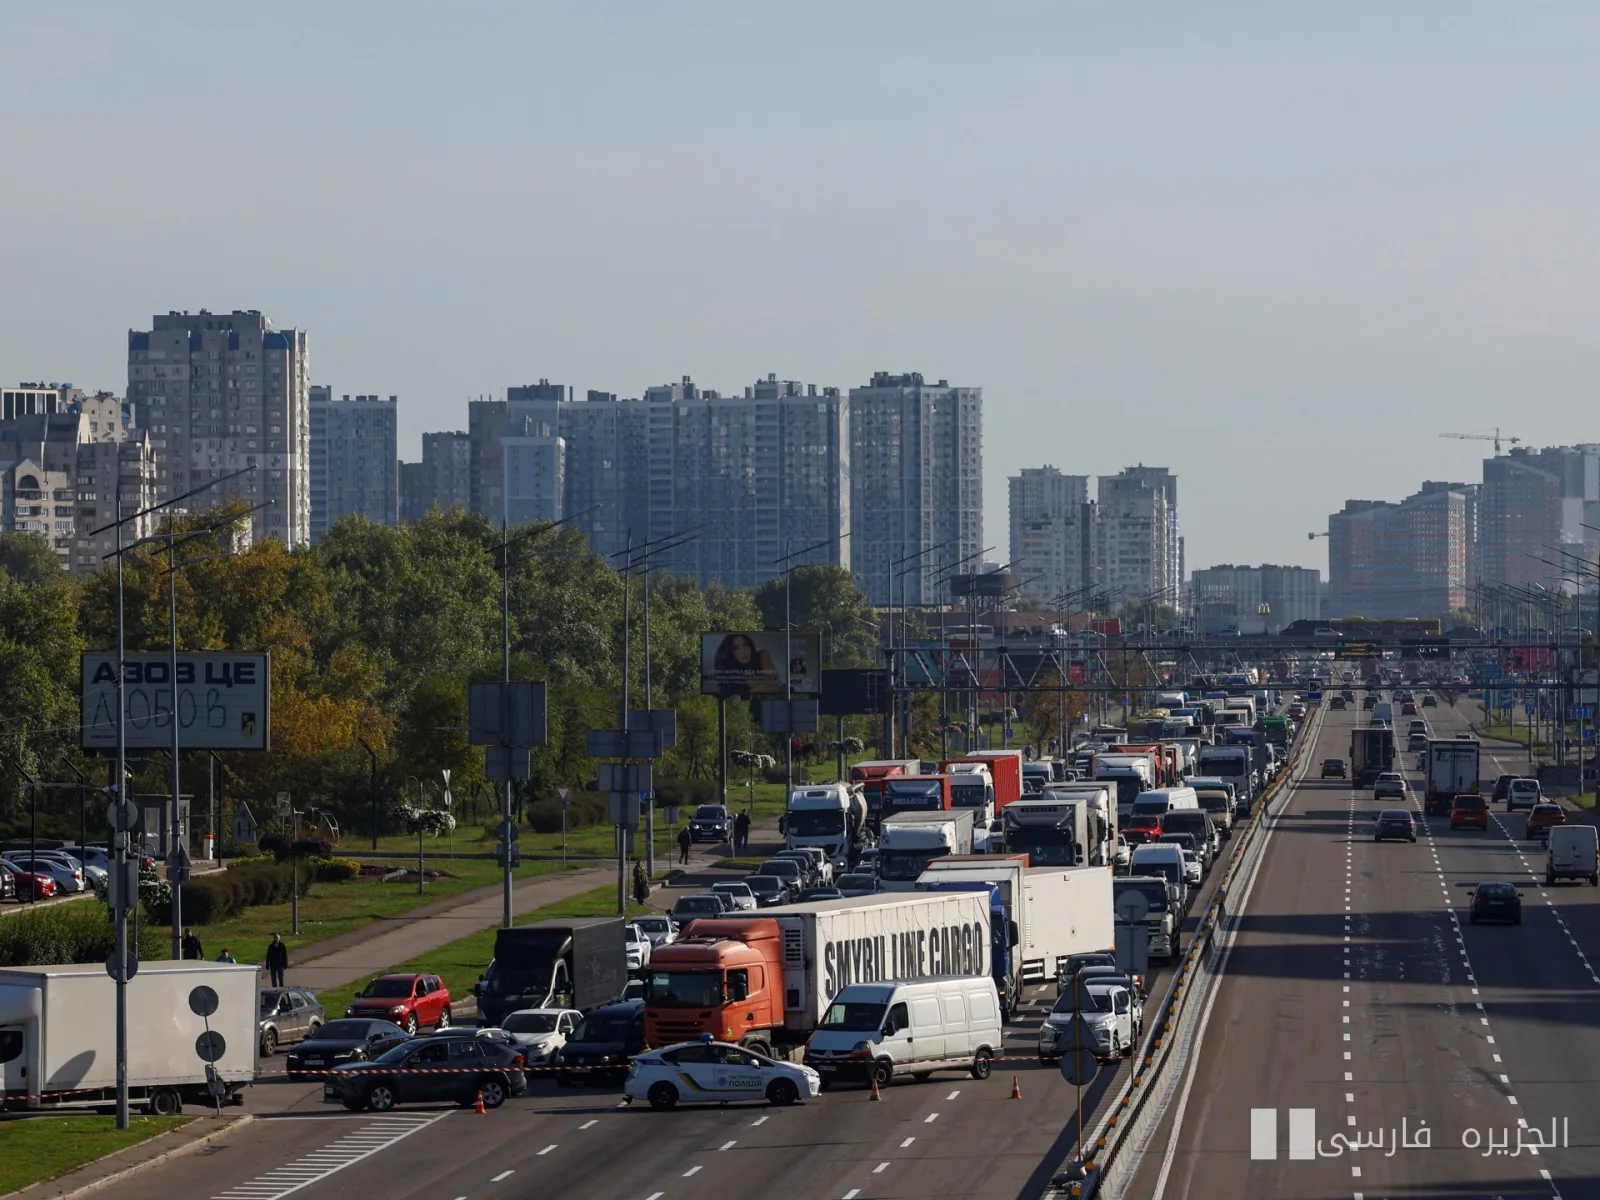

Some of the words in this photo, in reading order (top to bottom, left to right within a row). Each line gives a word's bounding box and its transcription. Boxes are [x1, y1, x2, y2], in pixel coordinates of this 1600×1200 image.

[91, 662, 195, 684] АЗОВ
[205, 662, 256, 688] ЦЕ
[929, 921, 983, 976] CARGO
